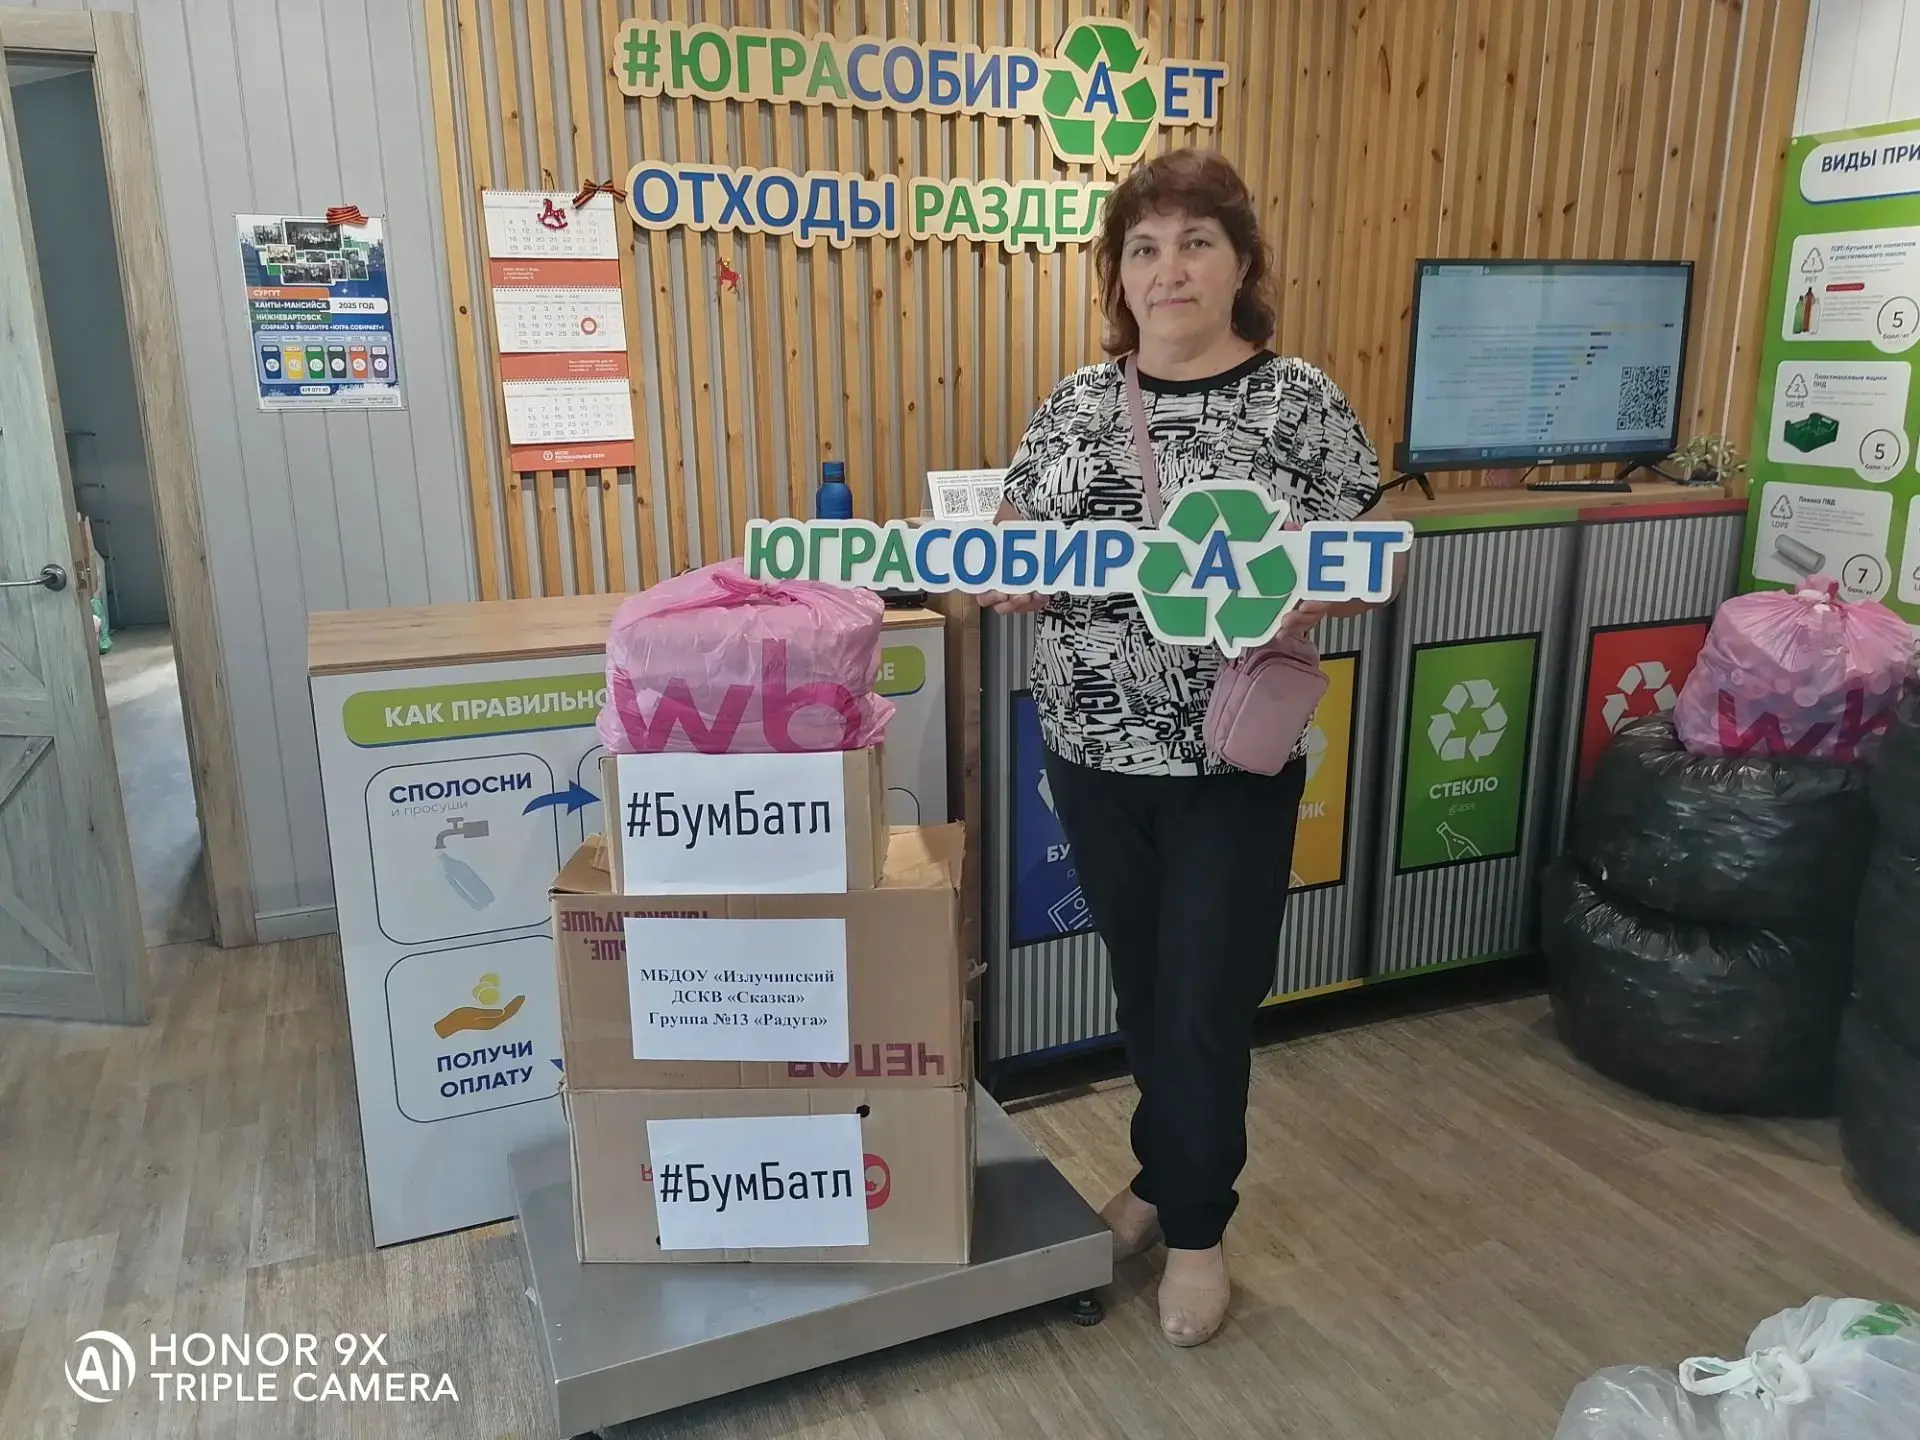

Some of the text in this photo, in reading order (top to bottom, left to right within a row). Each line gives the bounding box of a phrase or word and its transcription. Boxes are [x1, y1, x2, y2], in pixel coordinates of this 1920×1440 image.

[1821, 149, 1877, 173] ВИДЫ
[632, 167, 895, 243] ОТХОДЫ
[255, 300, 327, 309] ХАНТЫ-МАНСИЙСК
[359, 302, 375, 310] ГОД
[256, 313, 322, 321] НИЖНЕВАРТОВСК
[1892, 311, 1904, 328] 5
[1785, 400, 1805, 408] HDPE
[1874, 443, 1885, 461] 5
[1771, 520, 1789, 529] LDPE
[1858, 567, 1868, 584] 7
[613, 638, 862, 754] wb
[385, 687, 608, 728] КАК ПРАВИЛЬНО
[389, 772, 532, 803] СПОЛОСНИ
[1429, 776, 1498, 799] СТЕКЛО
[391, 801, 468, 819] и просуши
[1298, 800, 1325, 820] ИК
[627, 790, 831, 849] #БумБатл
[640, 968, 834, 986] МБДОУ «Излучинский
[671, 990, 805, 1004] ДСКВ «Сказка»
[649, 1012, 827, 1029] Группа №13 «Радуга»
[437, 1040, 533, 1072] ПОЛУЧИ
[440, 1066, 533, 1098] ОПЛАТУ
[660, 1161, 852, 1212] #БумБатл
